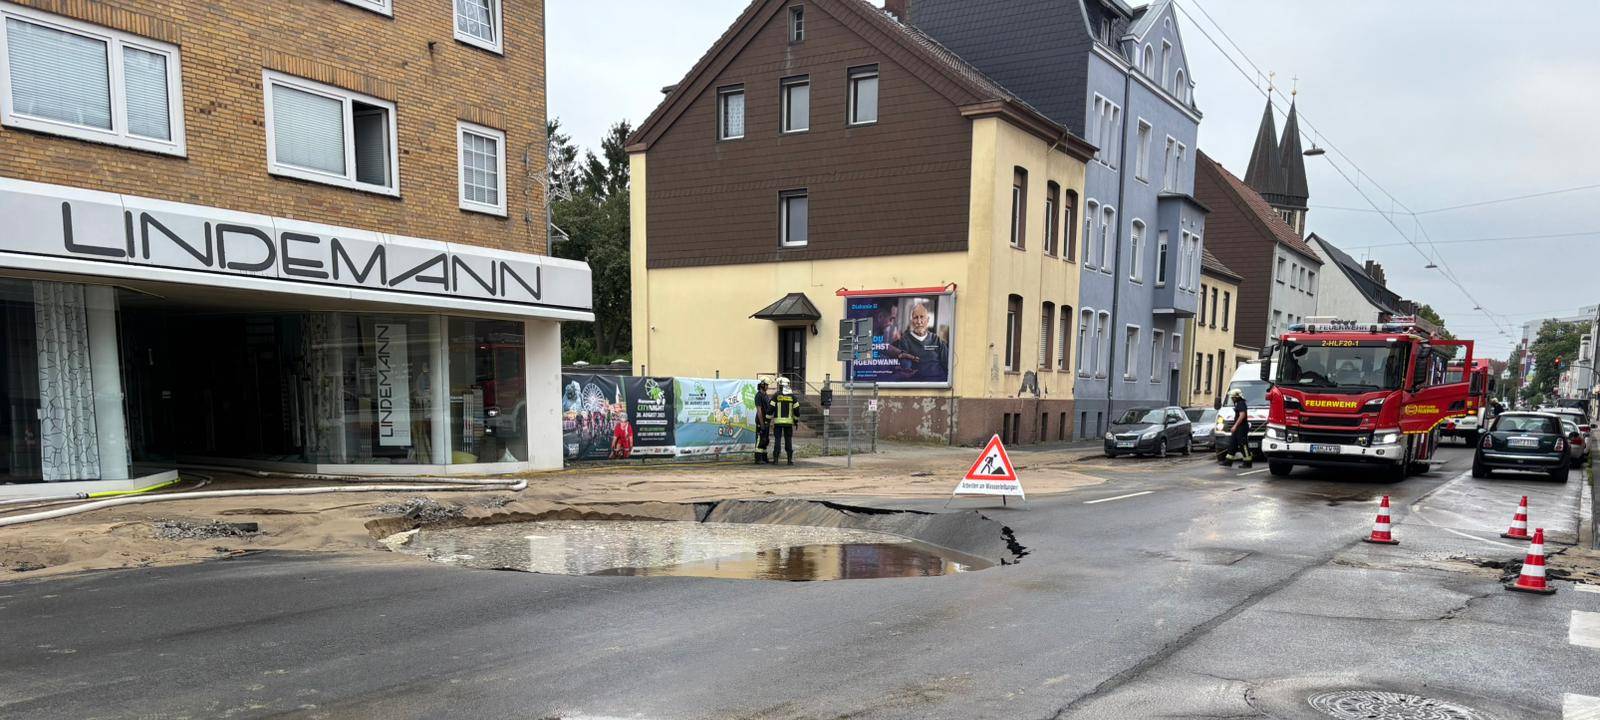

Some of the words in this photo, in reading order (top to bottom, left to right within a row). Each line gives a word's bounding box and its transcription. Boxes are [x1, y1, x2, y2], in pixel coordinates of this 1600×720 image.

[62, 201, 542, 301] LINDEMANN
[377, 325, 394, 438] LINDEMANN
[1305, 400, 1357, 408] FEUERWEHR
